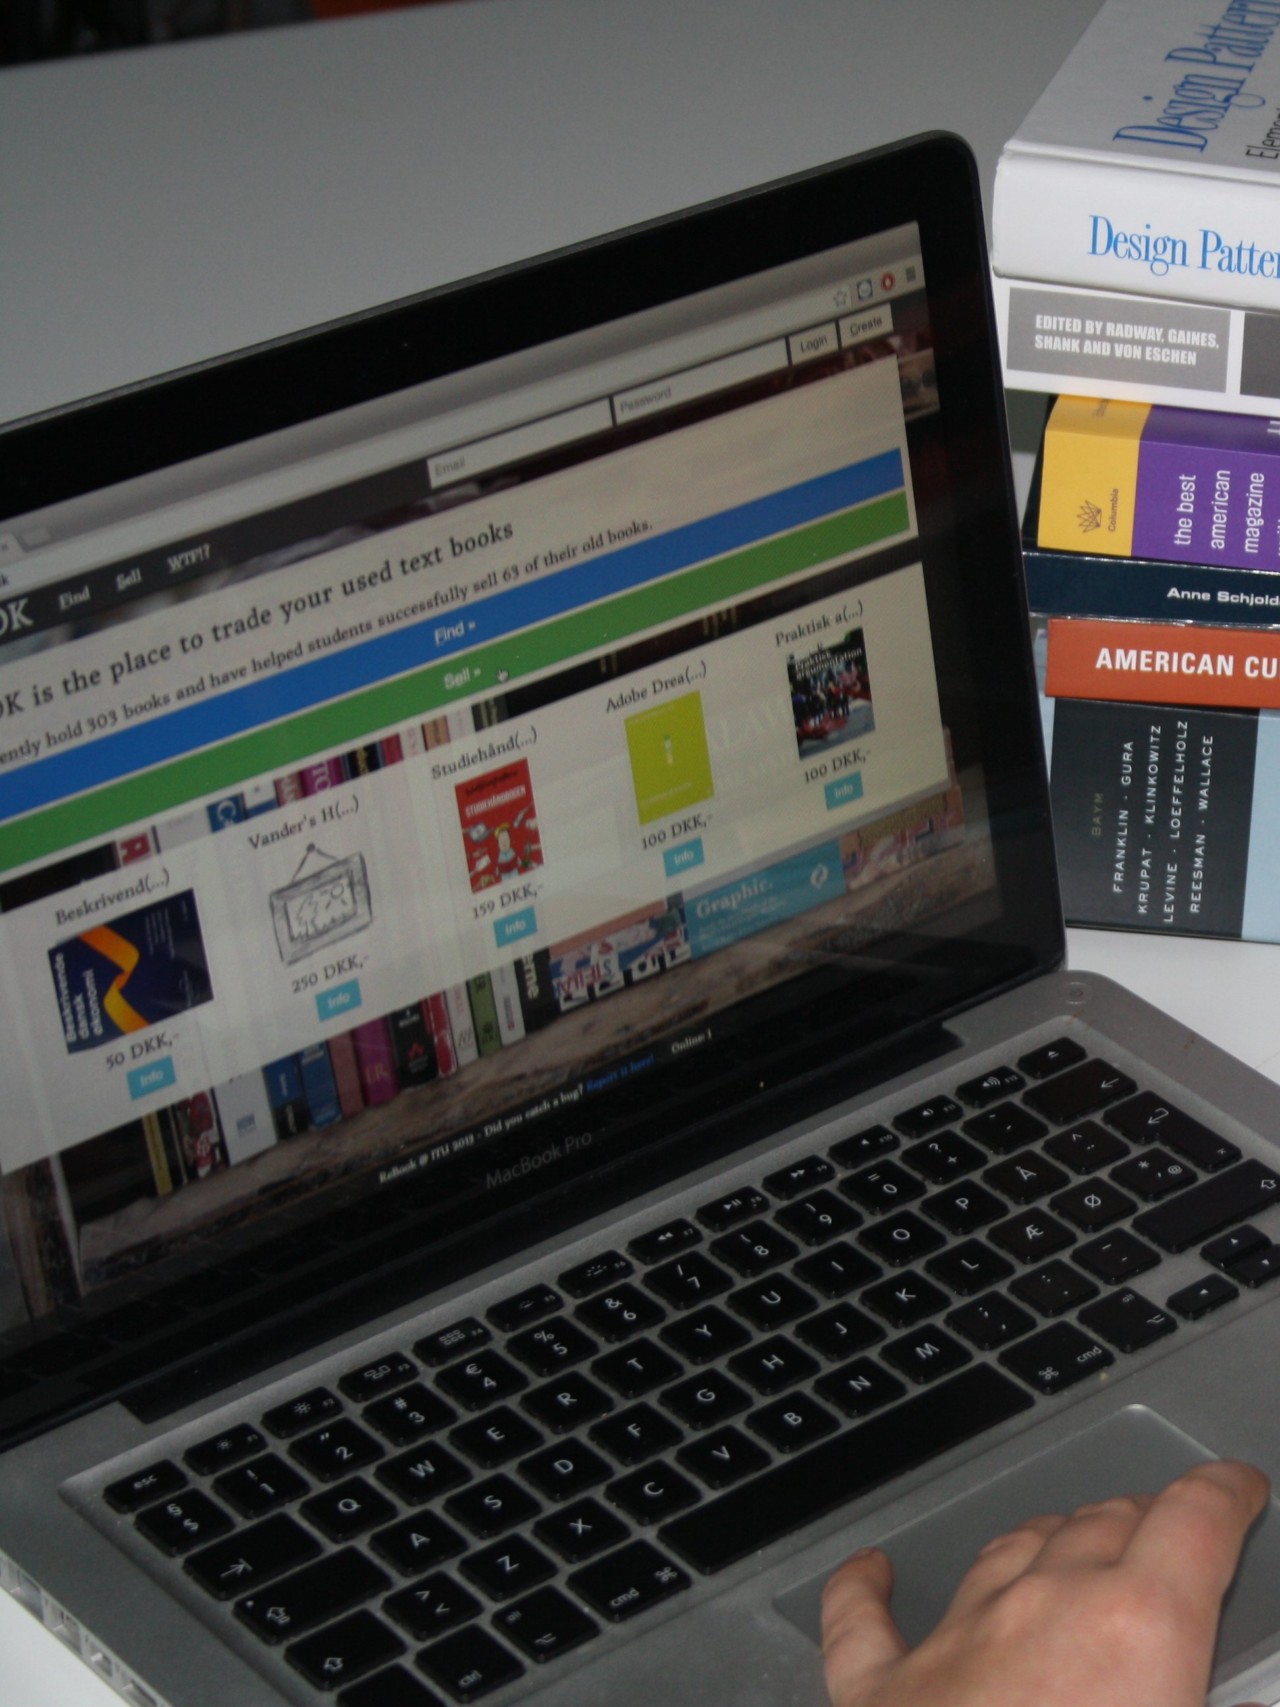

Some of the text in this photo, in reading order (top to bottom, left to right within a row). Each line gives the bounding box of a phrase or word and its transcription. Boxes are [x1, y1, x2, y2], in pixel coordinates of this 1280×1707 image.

[1112, 73, 1266, 152] Design
[1088, 214, 1190, 277] Design
[800, 315, 882, 352] Login Create
[1036, 314, 1220, 349] EDITED BY RADWAY, GAINES,
[1035, 335, 1197, 366] SHANK AND VON ESCHEN
[1107, 488, 1119, 532] Columbia
[1174, 474, 1197, 546] the best
[1211, 469, 1231, 550] american
[1244, 472, 1265, 553] magazine
[58, 585, 91, 610] Find
[115, 567, 142, 592] Sell
[1166, 586, 1212, 602] Anne
[32, 684, 54, 707] is
[62, 669, 101, 696] the
[109, 650, 171, 684] place
[179, 633, 204, 654] to
[212, 604, 272, 644] trade
[280, 587, 333, 625] your
[341, 563, 393, 598] used
[400, 546, 443, 576] text
[449, 522, 514, 558] books
[775, 613, 831, 648] Praktisk
[45, 721, 83, 748] hold
[123, 695, 171, 720] books
[176, 678, 205, 702] and
[210, 666, 248, 688] have
[252, 640, 303, 674] helped
[307, 620, 373, 655] students
[378, 585, 468, 627] successfully
[473, 571, 498, 594] sell
[525, 556, 542, 574] of
[544, 544, 578, 569] their
[582, 533, 604, 554] old
[434, 620, 465, 646] Find
[443, 665, 471, 690] Sell
[1096, 647, 1234, 676] AMERICAN
[605, 687, 648, 714] Adobe
[804, 763, 829, 784] 100
[248, 814, 317, 849] Vander's
[1113, 741, 1134, 893] FRANKLIN GURA
[1138, 725, 1162, 914] KRUPAT KLINKOWITZ
[1164, 720, 1188, 923] LEVINE LOEFFELHOLZ
[1190, 735, 1214, 914] REESMAN WALLACE
[641, 829, 667, 850] 100
[292, 972, 319, 994] 250
[106, 1052, 125, 1071] 50
[485, 1131, 593, 1190] MacBook Pro
[761, 1354, 785, 1370] H
[915, 1341, 940, 1360] M
[1076, 1345, 1103, 1364] cmd
[133, 1474, 157, 1490] esc
[409, 1459, 436, 1478] W
[338, 1498, 361, 1513] Q
[609, 1587, 640, 1608] cmd
